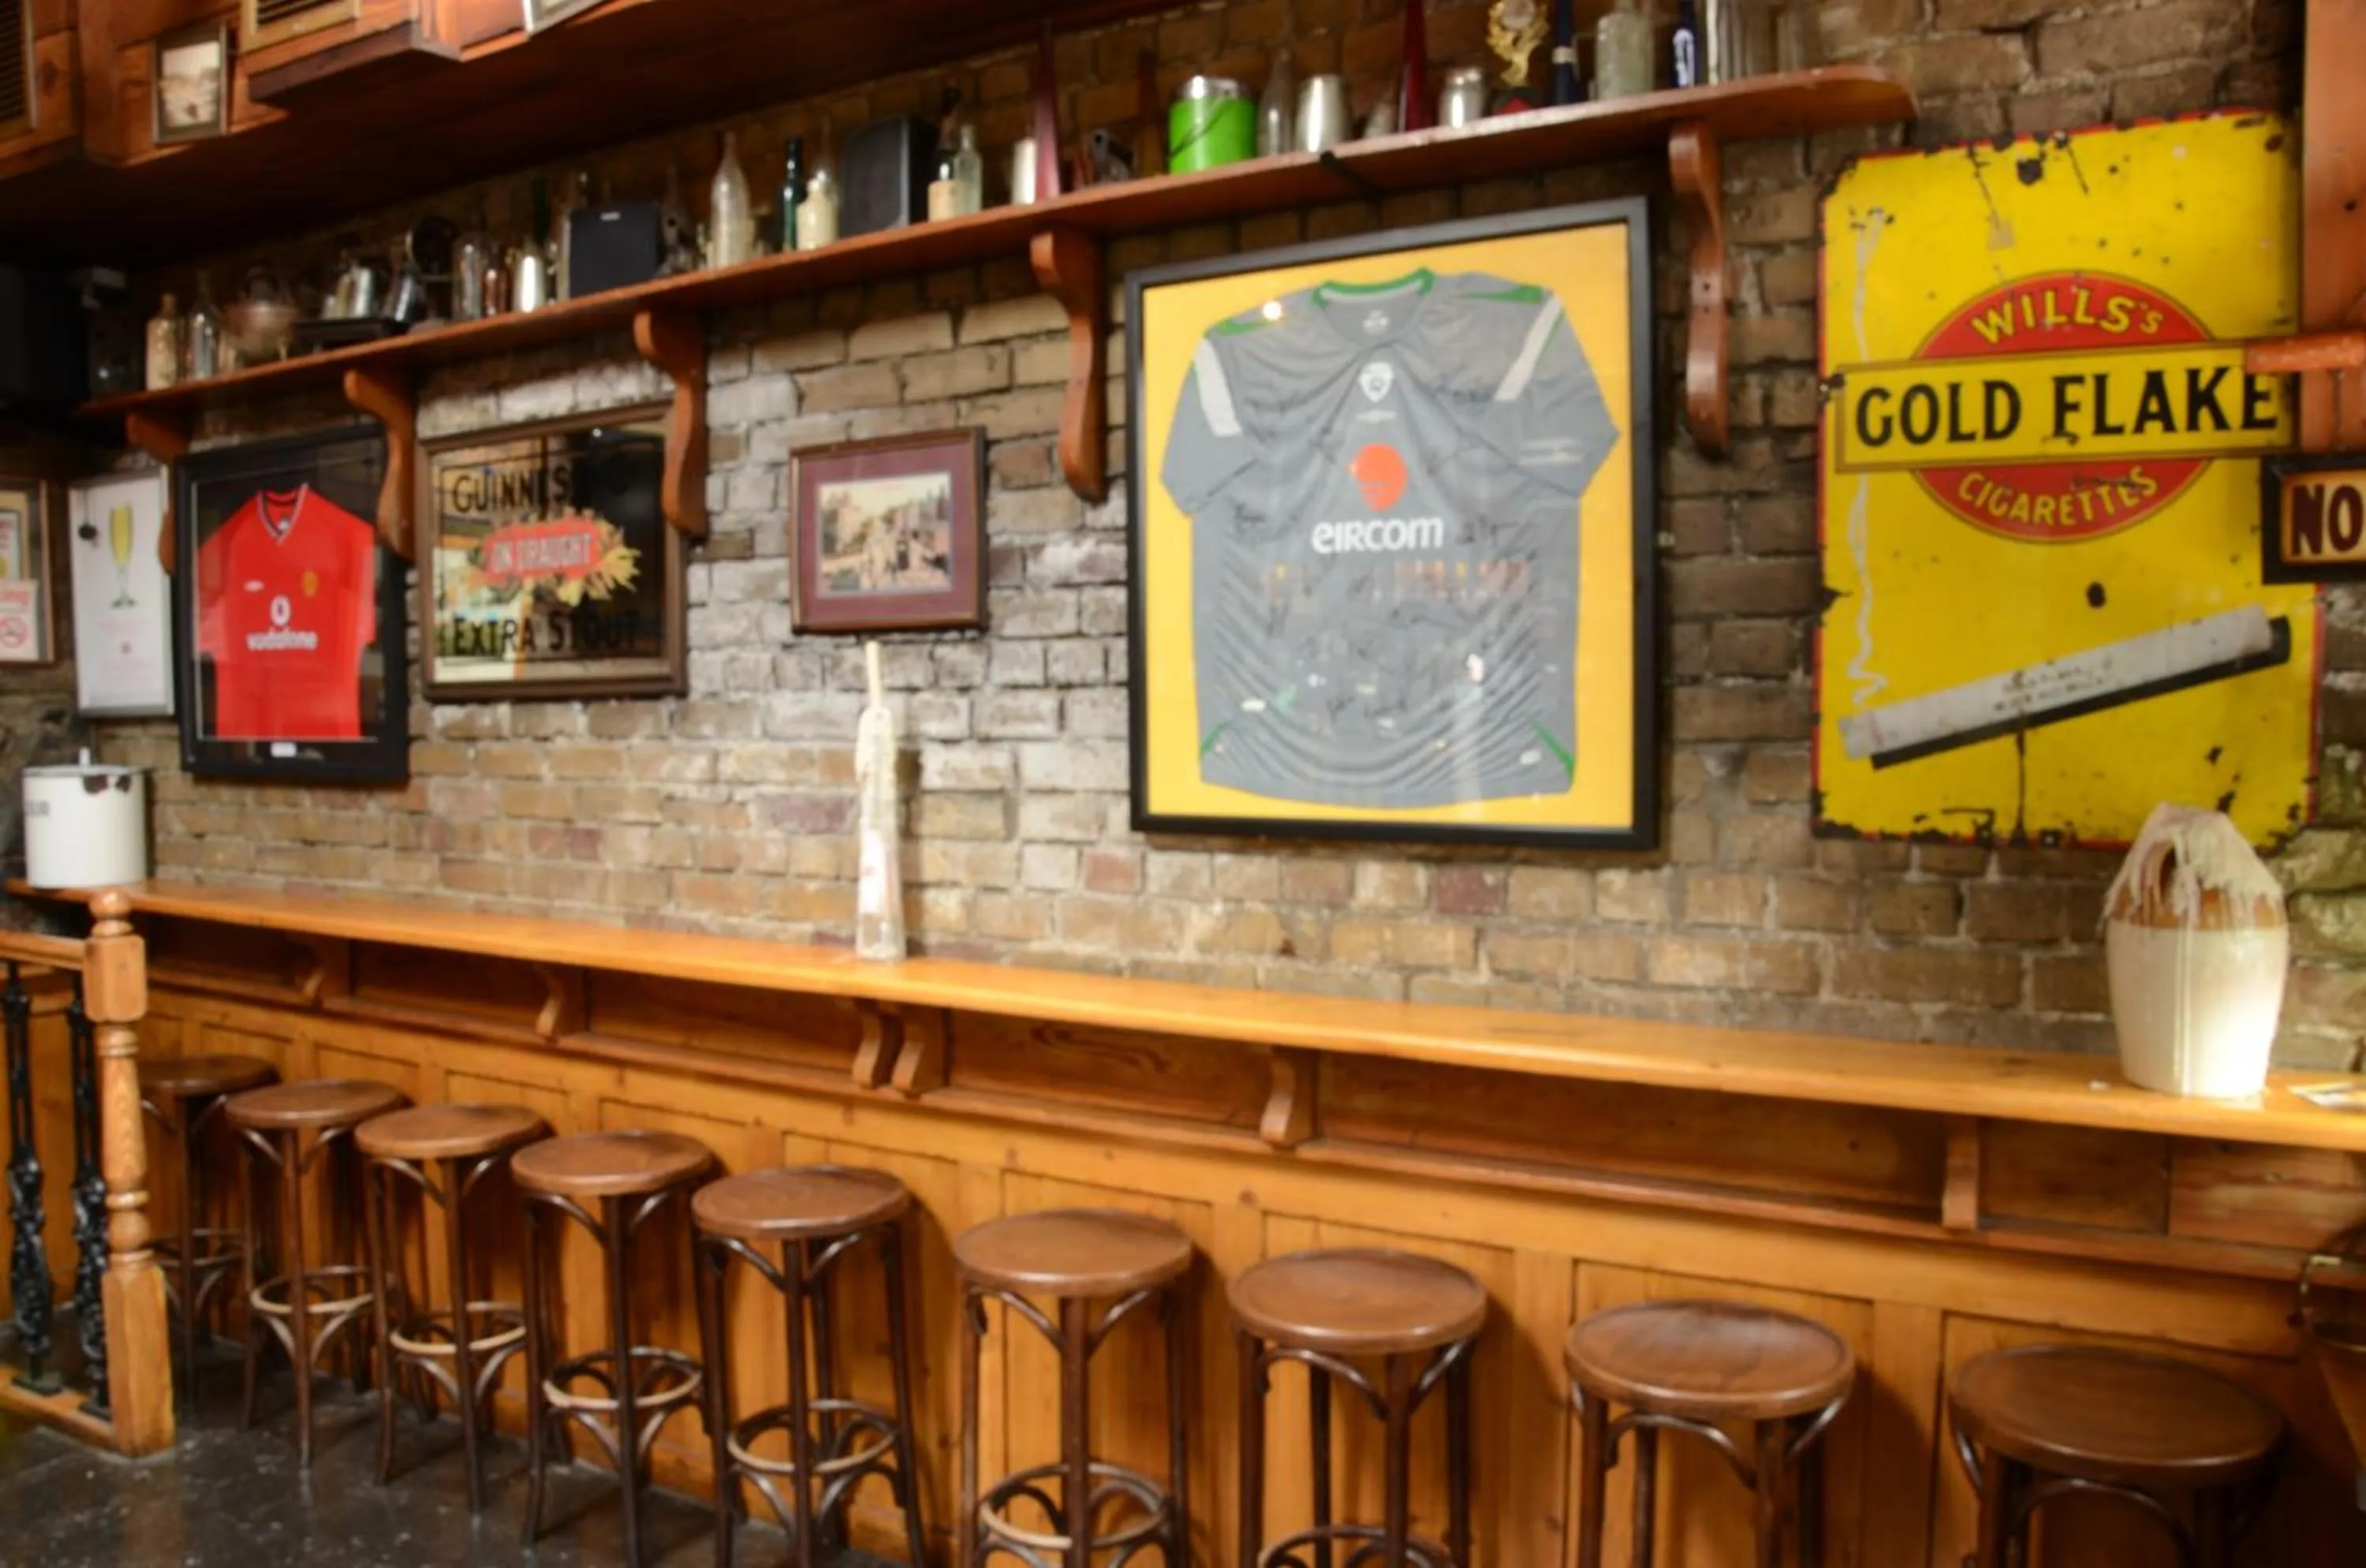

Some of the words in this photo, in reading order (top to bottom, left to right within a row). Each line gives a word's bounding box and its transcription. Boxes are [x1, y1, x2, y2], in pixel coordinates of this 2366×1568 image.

[1855, 379, 2021, 448] GOLD
[2051, 365, 2278, 440] FLAKE
[1957, 465, 2159, 527] CIGARETTES
[2290, 483, 2364, 555] NO
[453, 617, 537, 655] EXTRA
